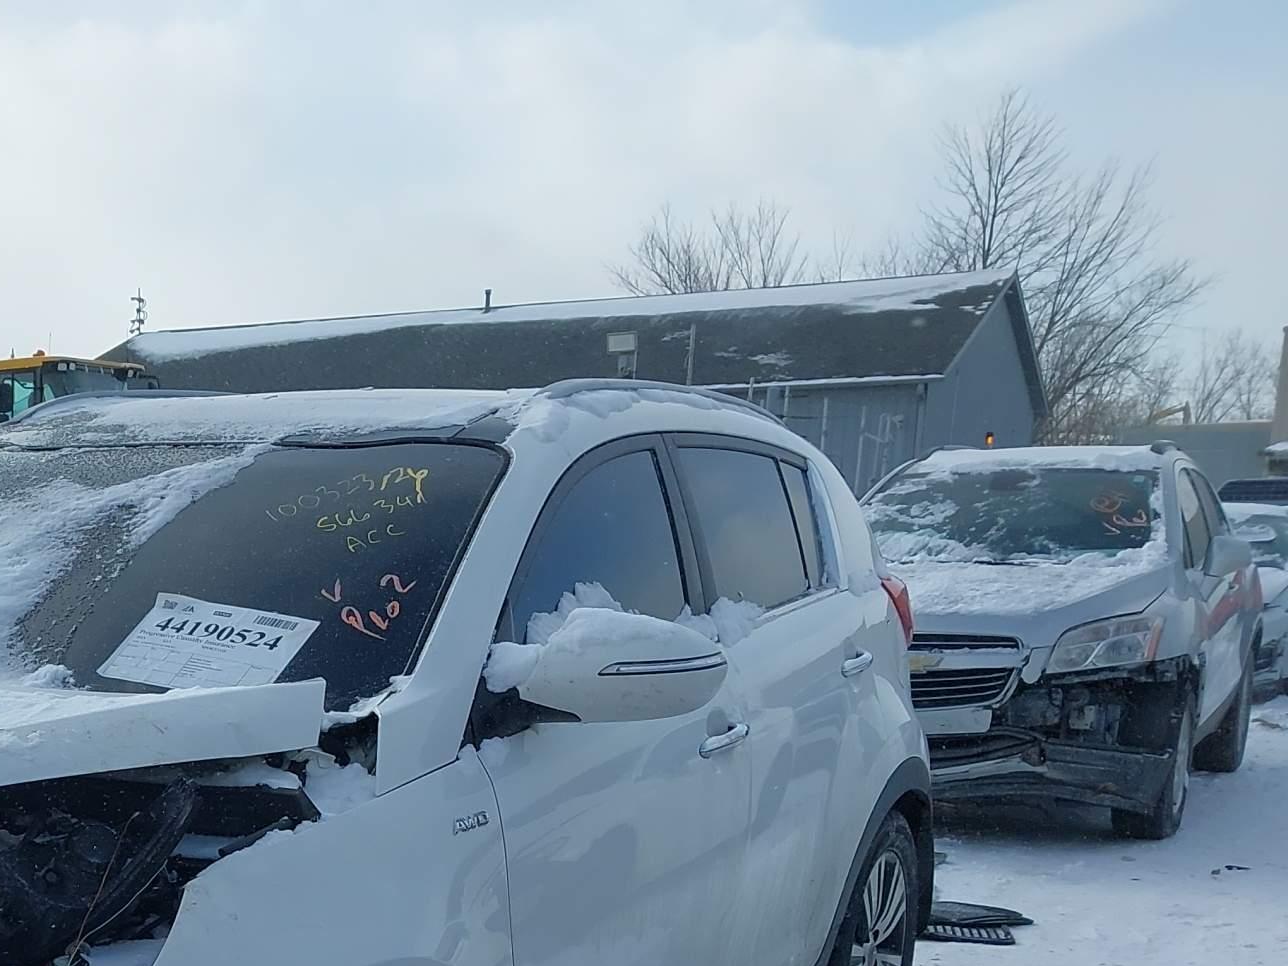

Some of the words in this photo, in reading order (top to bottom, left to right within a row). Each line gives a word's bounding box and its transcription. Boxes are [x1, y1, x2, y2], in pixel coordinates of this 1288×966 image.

[345, 523, 406, 552] ACC
[154, 616, 285, 651] 44190524
[452, 811, 489, 837] AWD
